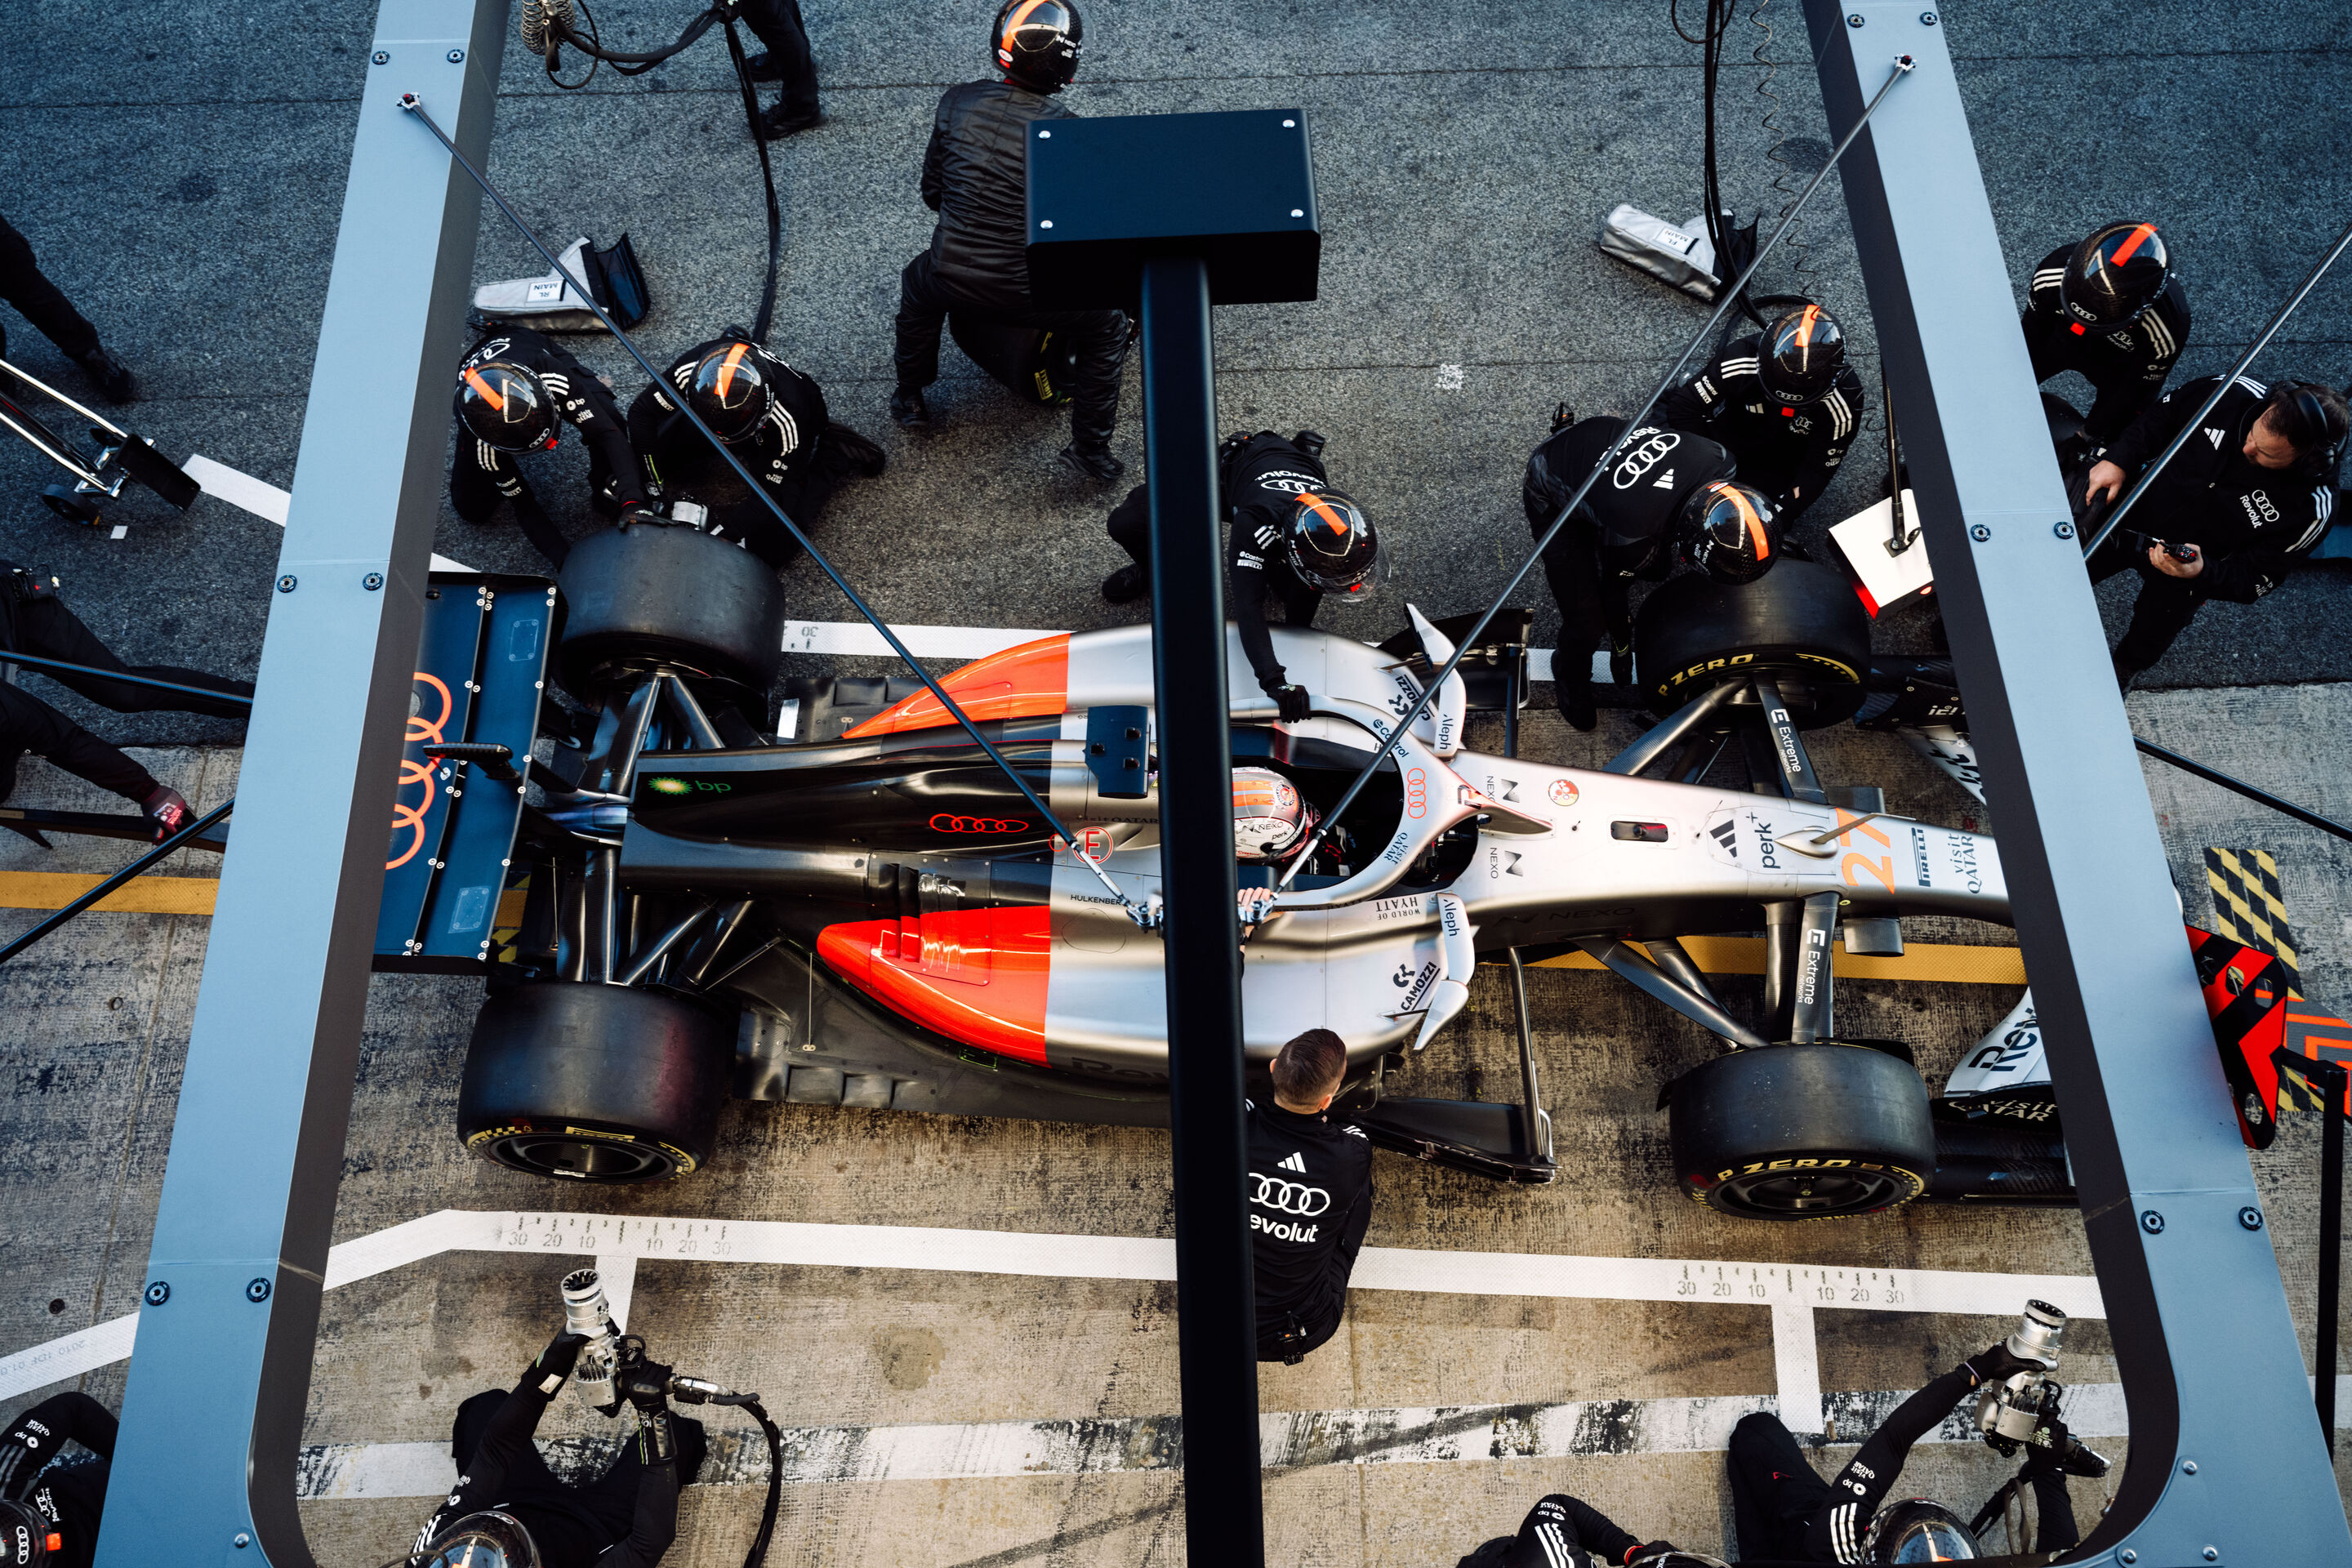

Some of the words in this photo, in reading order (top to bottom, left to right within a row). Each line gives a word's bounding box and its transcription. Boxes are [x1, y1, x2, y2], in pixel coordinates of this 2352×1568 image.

[533, 283, 558, 291] MAIN
[2239, 494, 2263, 529] Revolut
[1658, 684, 1668, 696] P
[1670, 653, 1754, 685] ZERO
[1380, 726, 1410, 758] Catrol
[1439, 714, 1454, 750] Aleph
[1779, 727, 1802, 772] Extreme
[1780, 749, 1793, 773] networks
[695, 781, 731, 793] bp
[1085, 831, 1100, 860] E
[1384, 832, 1408, 861] QATAR
[1393, 844, 1409, 865] visit
[1835, 807, 1895, 894] 27
[1911, 827, 1931, 887] PIRELLI
[1948, 834, 1964, 874] visit
[1490, 847, 1499, 880] NEXO
[1961, 835, 1982, 894] QATAR
[1071, 894, 1125, 906] HULKENBER
[1376, 897, 1419, 912] HYATT
[1392, 908, 1421, 918] WORLD
[1550, 907, 1635, 920] NEXO
[1443, 898, 1460, 937] Aleph
[1401, 961, 1437, 1011] CAMOZZI
[1804, 951, 1820, 1004] Extreme
[1717, 1169, 1734, 1181] P
[1744, 1159, 1851, 1174] ZERO
[1250, 1214, 1319, 1242] evolut
[509, 1232, 528, 1245] 30
[543, 1233, 562, 1247] 20
[579, 1236, 595, 1249] 10
[647, 1238, 662, 1251] 10
[679, 1239, 697, 1254] 20
[713, 1241, 731, 1255] 30
[1677, 1281, 1696, 1295] 30
[1713, 1282, 1731, 1296] 20
[1748, 1284, 1766, 1298] 10
[1817, 1287, 1834, 1301] 10
[1851, 1288, 1869, 1302] 20
[1886, 1290, 1904, 1303] 30
[1842, 1478, 1853, 1488] bp
[1851, 1467, 1866, 1479] visit
[1854, 1461, 1875, 1479] QATAR
